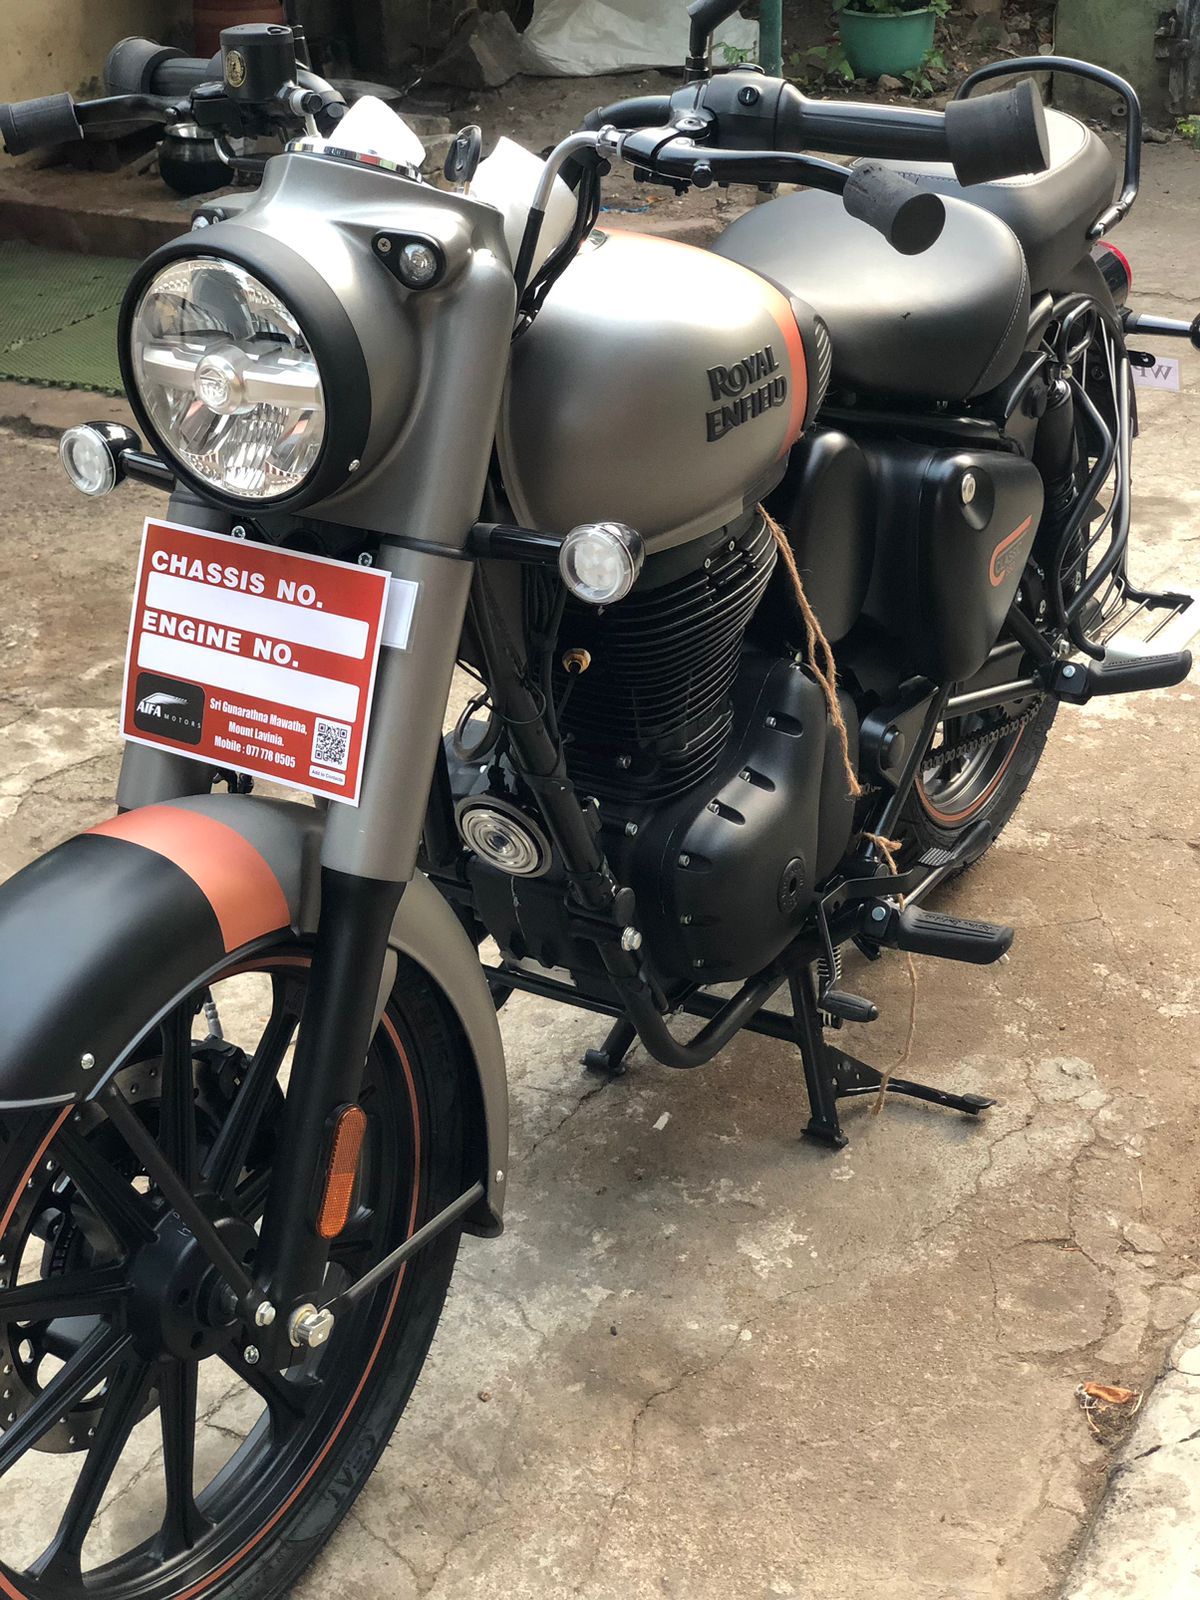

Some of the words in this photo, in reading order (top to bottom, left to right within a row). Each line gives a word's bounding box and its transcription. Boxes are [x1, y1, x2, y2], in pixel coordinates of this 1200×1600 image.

[706, 344, 779, 401] ROYAL
[706, 375, 787, 442] ENFIELD
[151, 550, 266, 594] CHASSIS
[277, 579, 323, 608] NO.
[142, 610, 242, 653] ENGINE
[252, 638, 299, 667] NO.
[136, 701, 161, 717] AIFA
[164, 713, 201, 729] MOTORS
[210, 698, 221, 711] Sri
[222, 701, 268, 724] Gunarathna
[269, 713, 307, 735] Mawatha,
[214, 735, 241, 753] Mobile
[246, 745, 259, 758] 077
[260, 748, 273, 762] 778
[274, 753, 296, 768] 0505
[228, 721, 253, 738] Mount
[254, 728, 284, 747] Lavinia.
